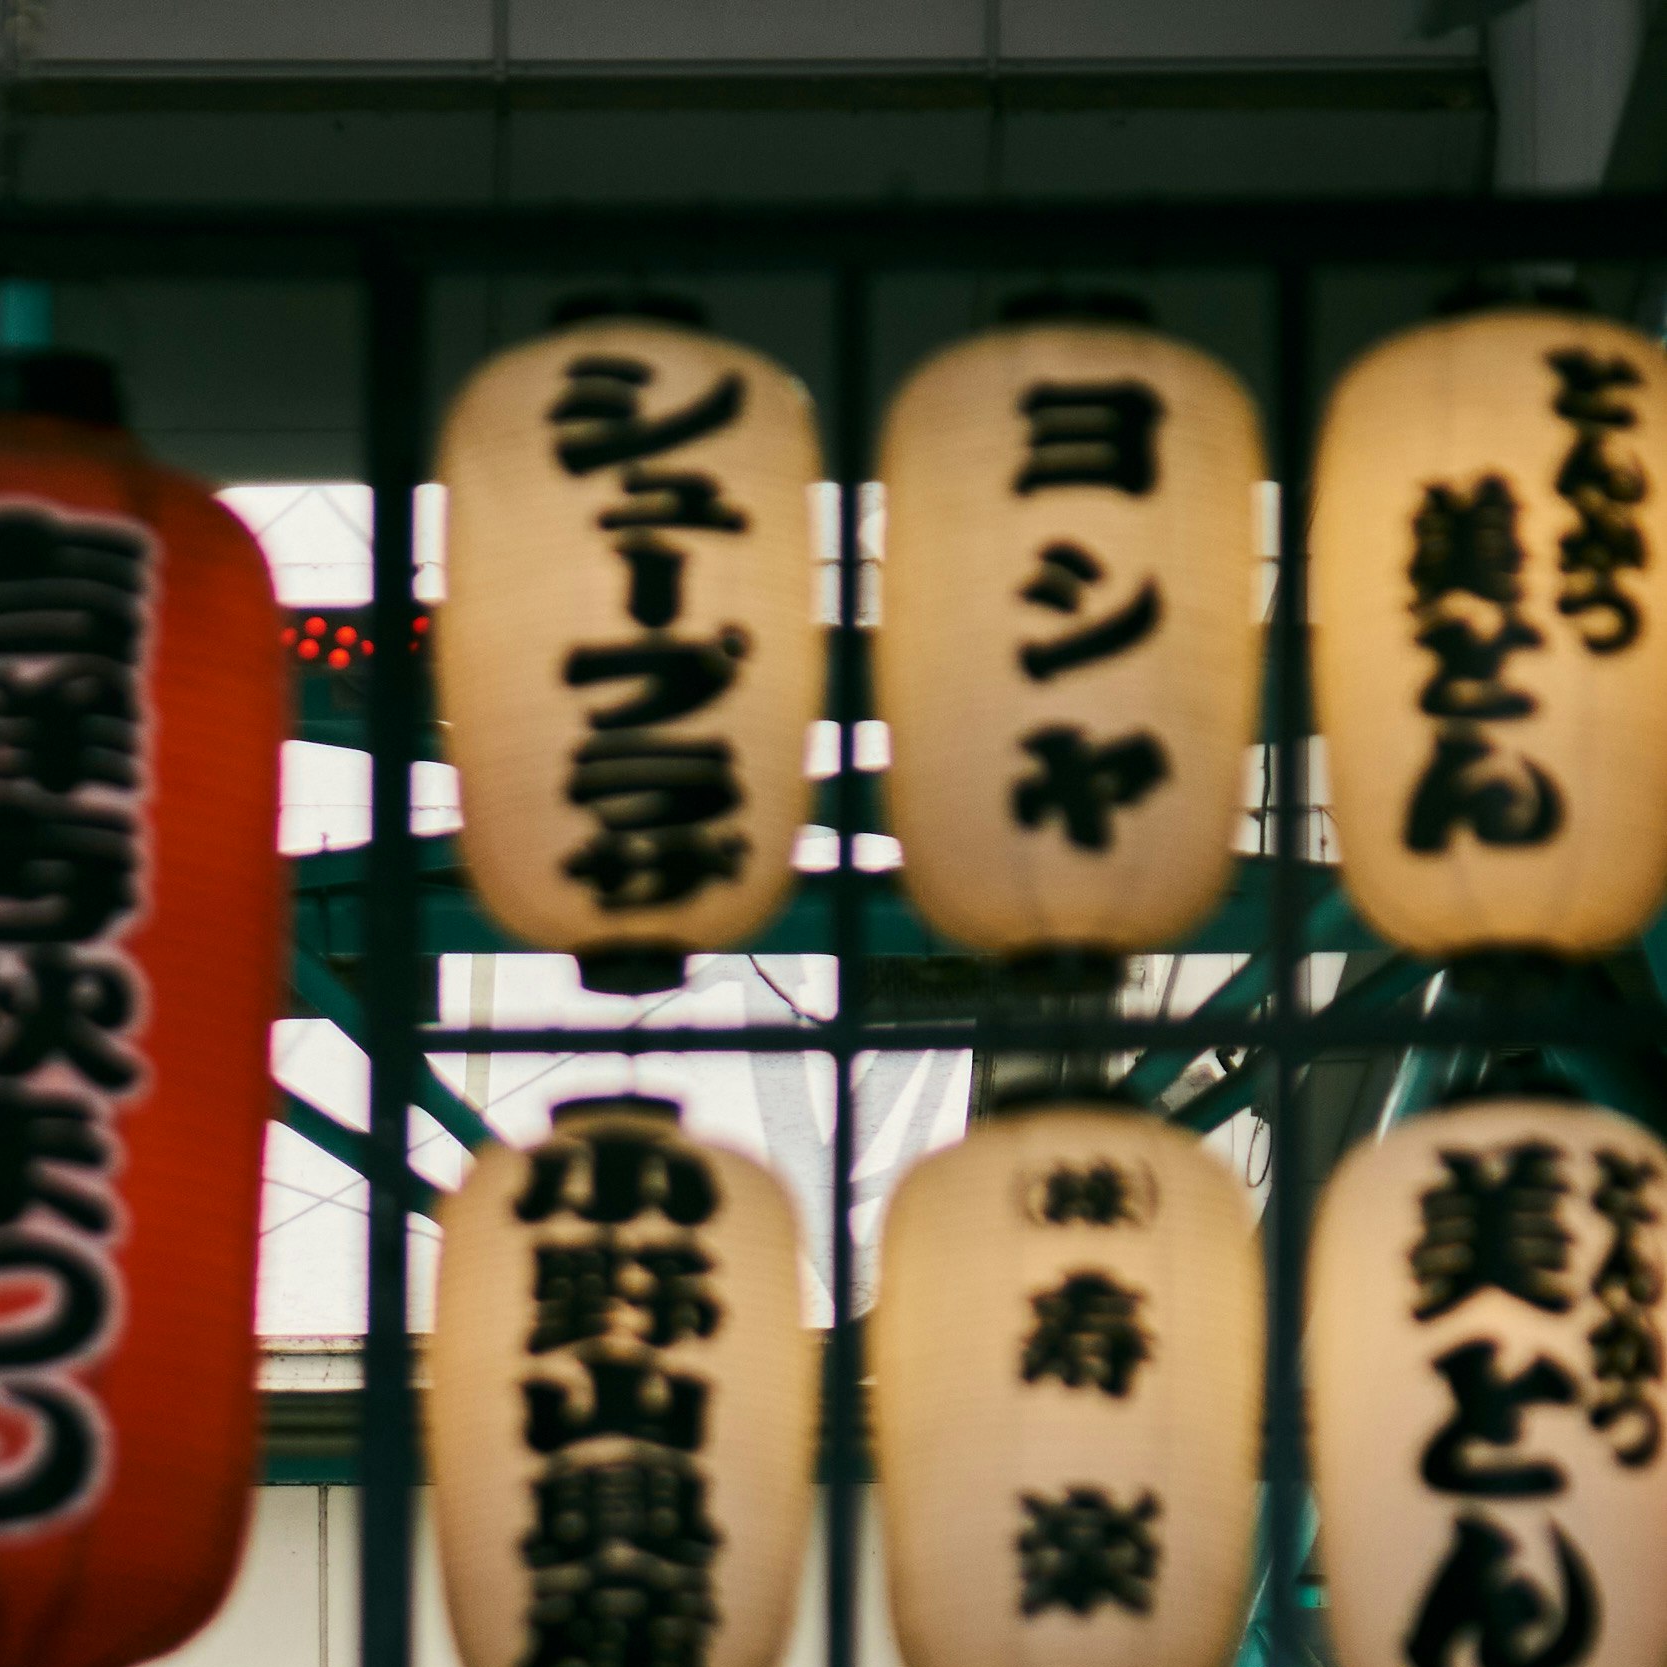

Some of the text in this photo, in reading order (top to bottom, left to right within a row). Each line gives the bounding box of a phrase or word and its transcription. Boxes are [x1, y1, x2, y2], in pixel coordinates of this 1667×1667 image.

[546, 354, 752, 911] シュープラザ
